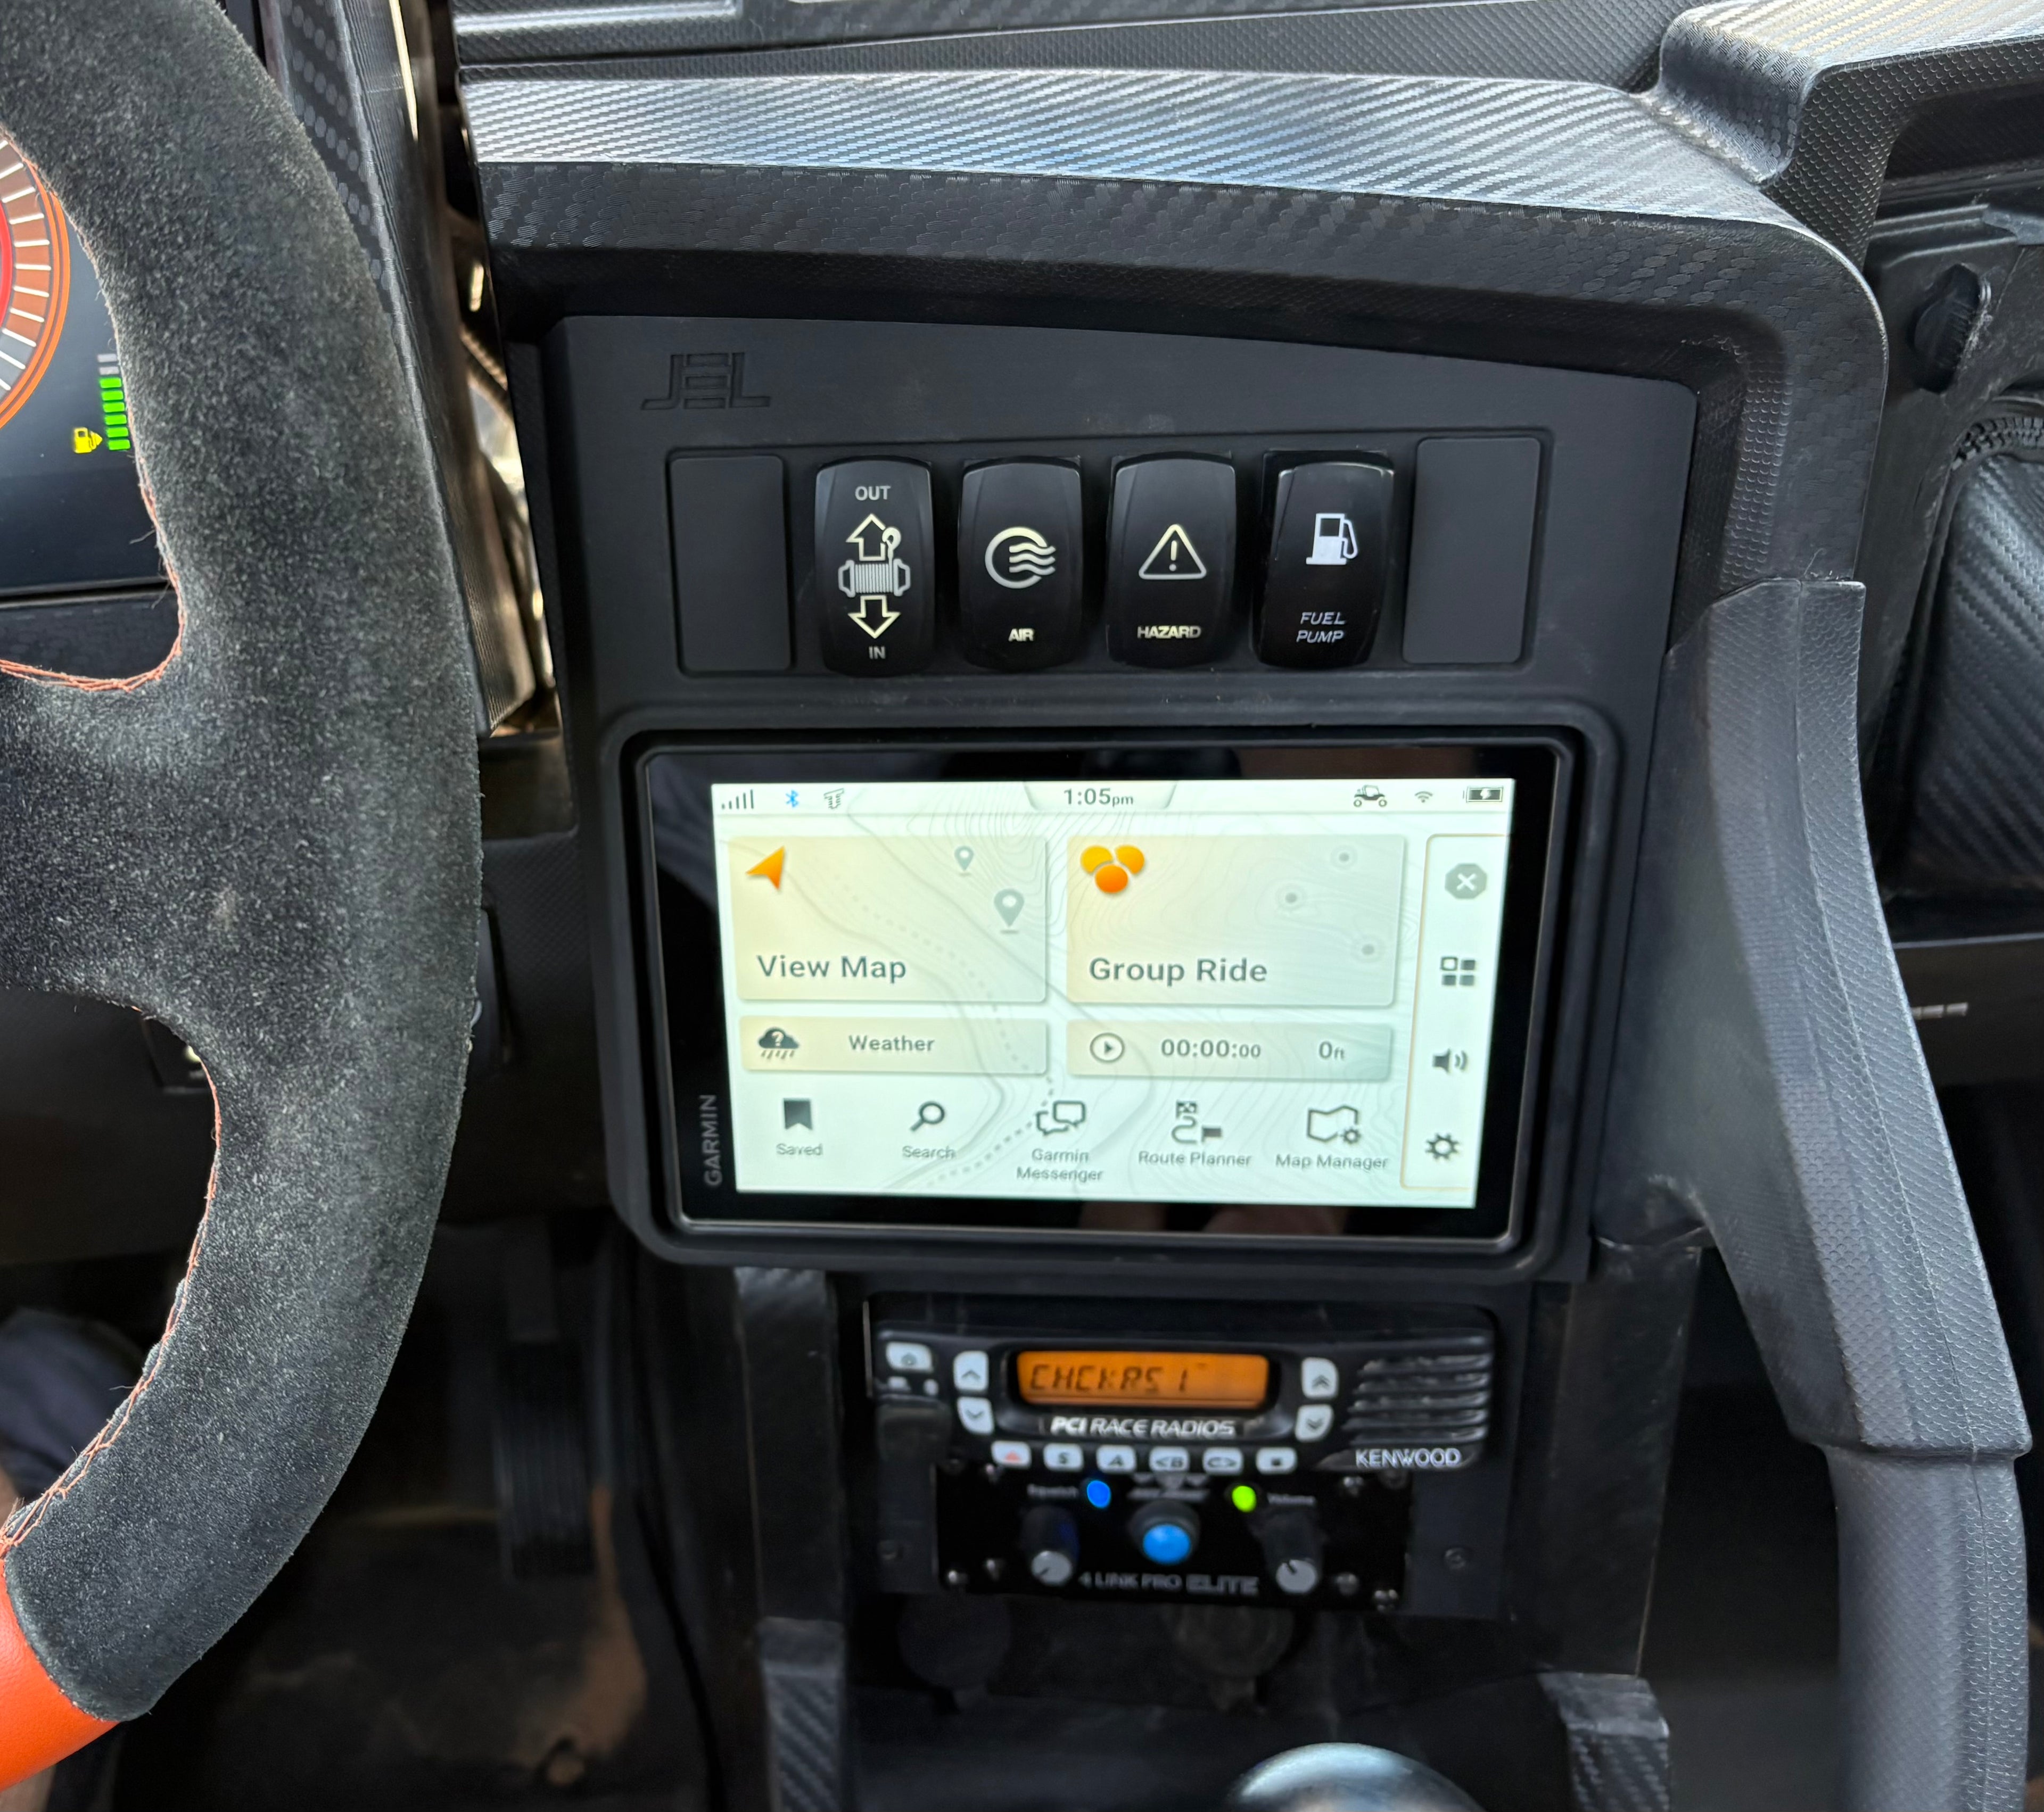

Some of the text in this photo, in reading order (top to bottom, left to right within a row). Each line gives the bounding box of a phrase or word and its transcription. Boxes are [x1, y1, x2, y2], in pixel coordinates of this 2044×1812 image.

[854, 485, 891, 501] OUT
[1300, 611, 1346, 625] FUEL
[1008, 627, 1034, 642] AIR
[1137, 625, 1201, 639] HAZARD
[1296, 630, 1344, 643] PUMP
[869, 647, 886, 659] IN
[756, 956, 906, 983] View Map
[1089, 958, 1267, 987] Group Ride
[848, 1035, 935, 1052] Weather
[1161, 1038, 1261, 1058] 00:00:00
[701, 1094, 722, 1186] GARMIN
[776, 1143, 824, 1156] Saved
[902, 1145, 956, 1160] Search
[1032, 1148, 1090, 1162] Garmin
[1139, 1151, 1253, 1167] Route Planner
[1275, 1153, 1389, 1171] Map Manager
[1017, 1167, 1104, 1182] Messenger
[1051, 1416, 1087, 1435] PCI
[1091, 1417, 1149, 1437] RACE
[1355, 1449, 1462, 1467] KENWOOD
[1141, 1573, 1183, 1591] PRO
[1185, 1573, 1260, 1595] ELITE
